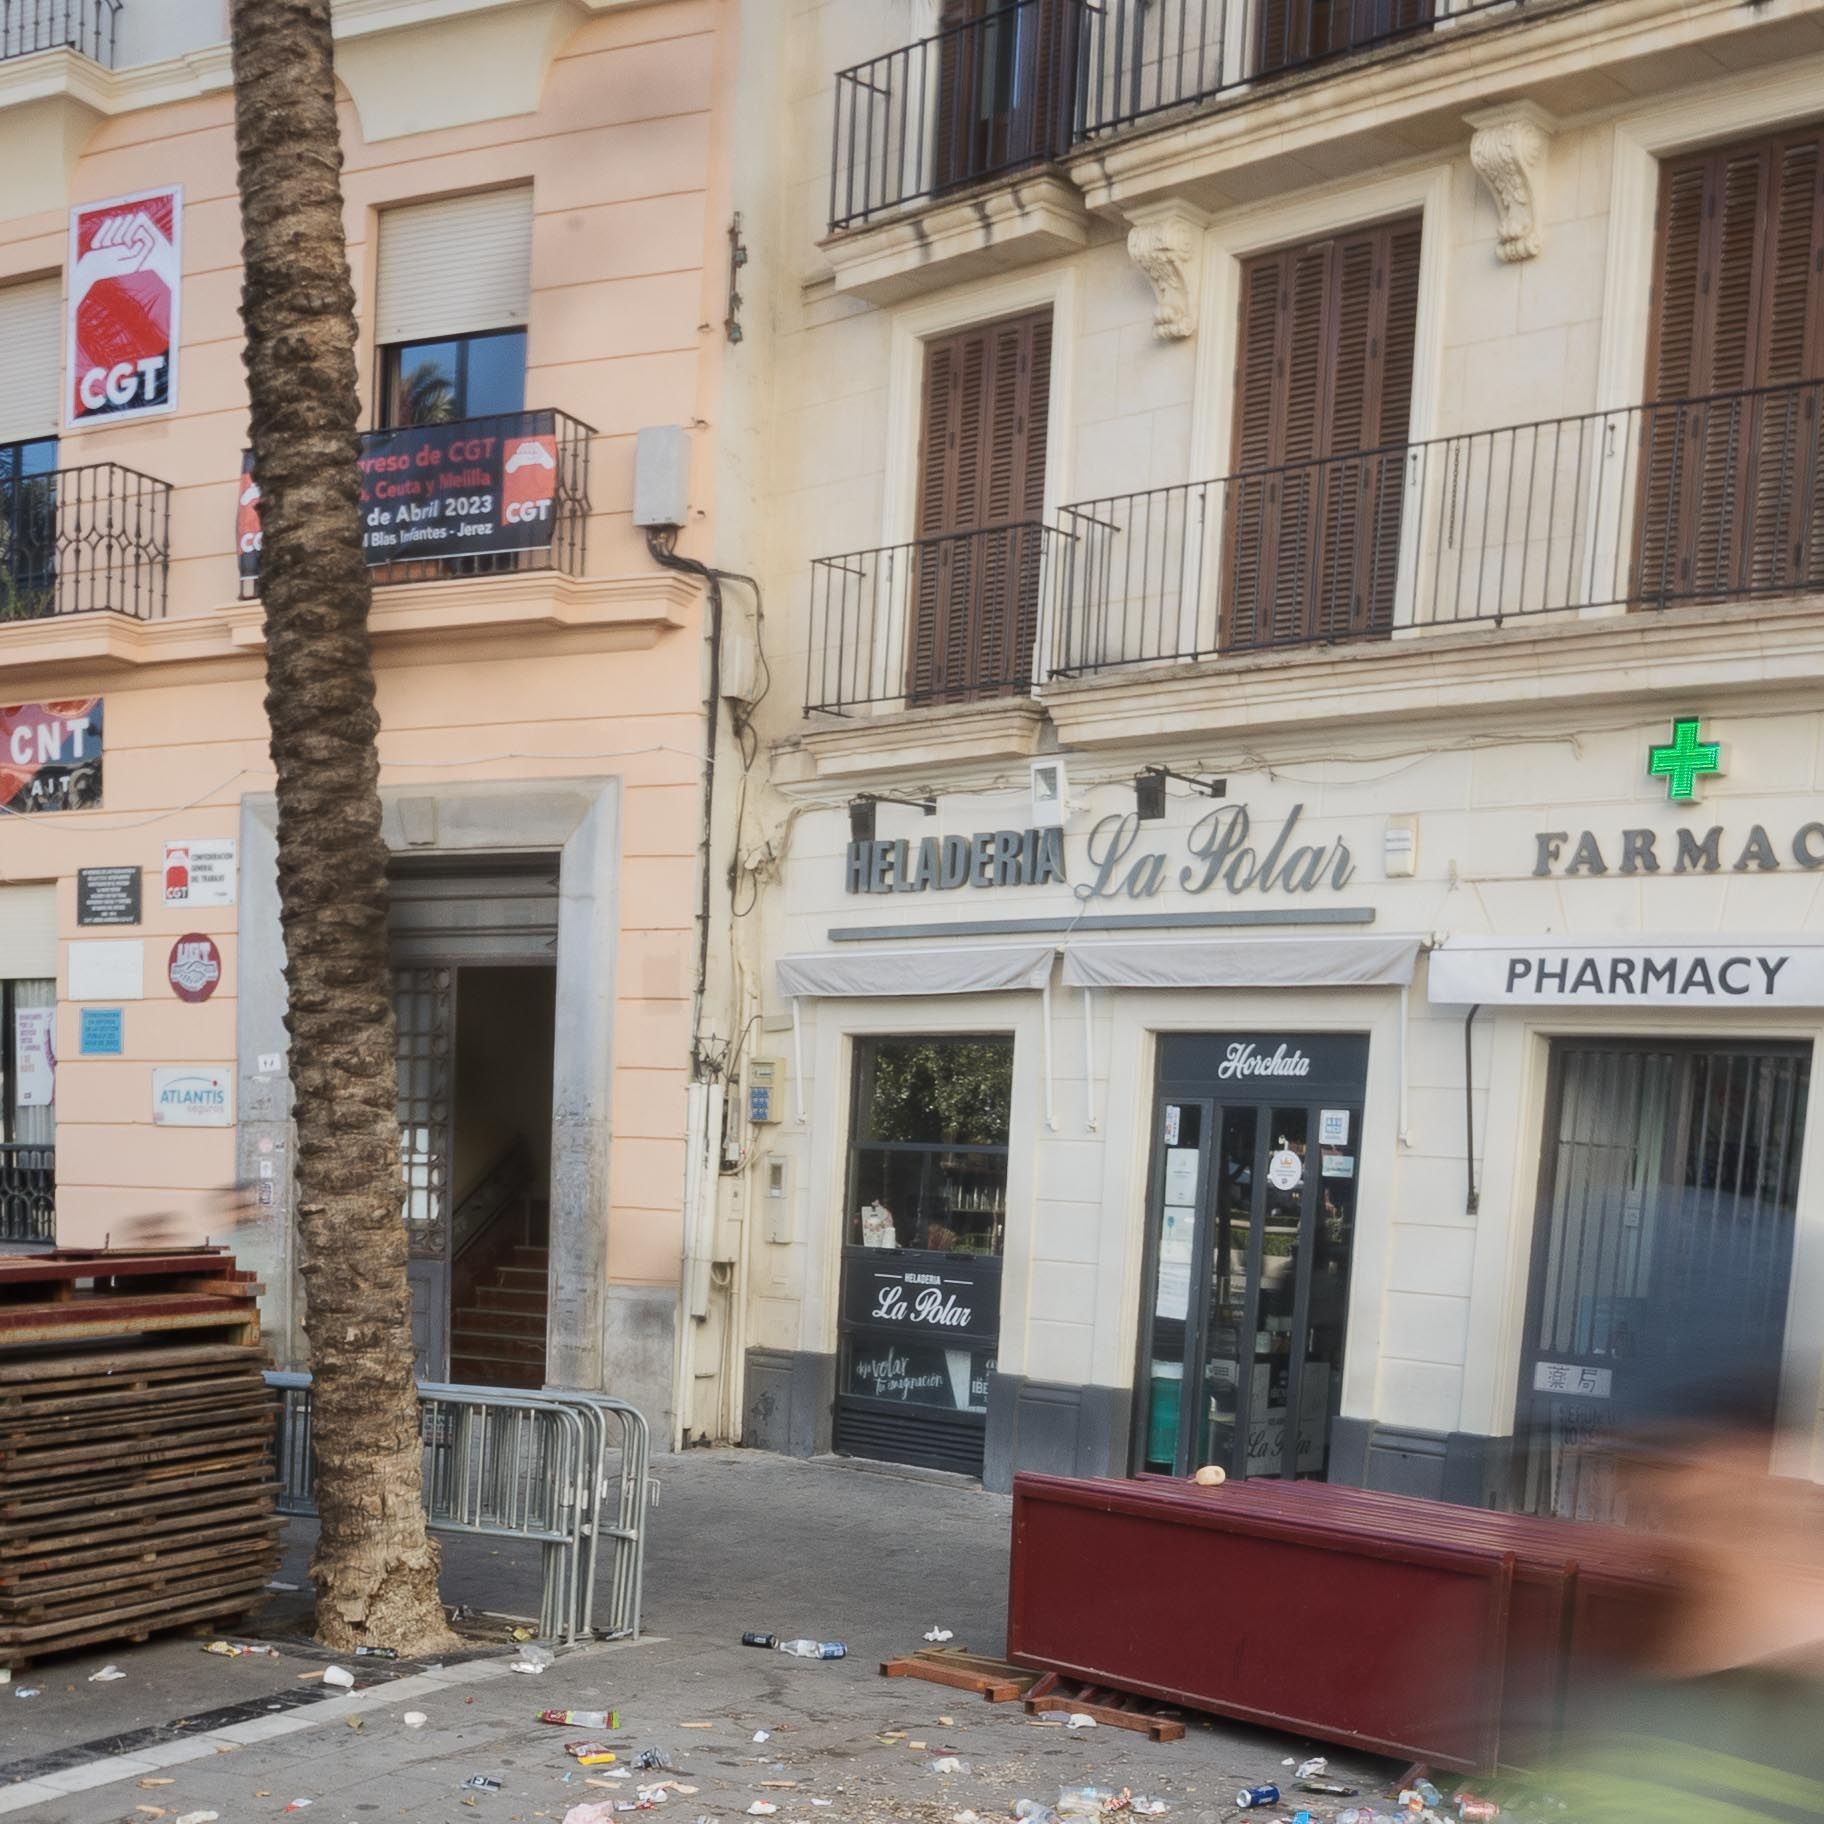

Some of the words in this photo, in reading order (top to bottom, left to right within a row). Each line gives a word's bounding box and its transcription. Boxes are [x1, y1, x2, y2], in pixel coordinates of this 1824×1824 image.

[79, 355, 165, 410] CGT
[415, 444, 442, 467] de
[447, 437, 496, 462] CGT
[375, 480, 421, 501] Ceuta
[425, 481, 435, 498] y
[439, 470, 491, 490] Melilla
[366, 505, 393, 527] de
[395, 499, 439, 523] Abril
[445, 495, 493, 516] 2023
[506, 499, 552, 524] CGT
[371, 529, 396, 547] Blas
[400, 525, 447, 545] Infantes
[457, 521, 493, 537] Jerez
[10, 717, 90, 765] CNT
[31, 776, 71, 797] AIT
[845, 826, 1066, 895] HELADERIA
[1073, 811, 1168, 901] La
[1179, 803, 1357, 896] Polar
[166, 887, 189, 899] CGT
[1505, 956, 1790, 996] PHARMACY
[1218, 1042, 1311, 1080] Horchata
[160, 1089, 224, 1104] ATLANTIS
[904, 1272, 942, 1286] HELADERIA
[872, 1286, 908, 1320] La
[909, 1288, 972, 1327] Polar
[871, 1346, 910, 1378] volar
